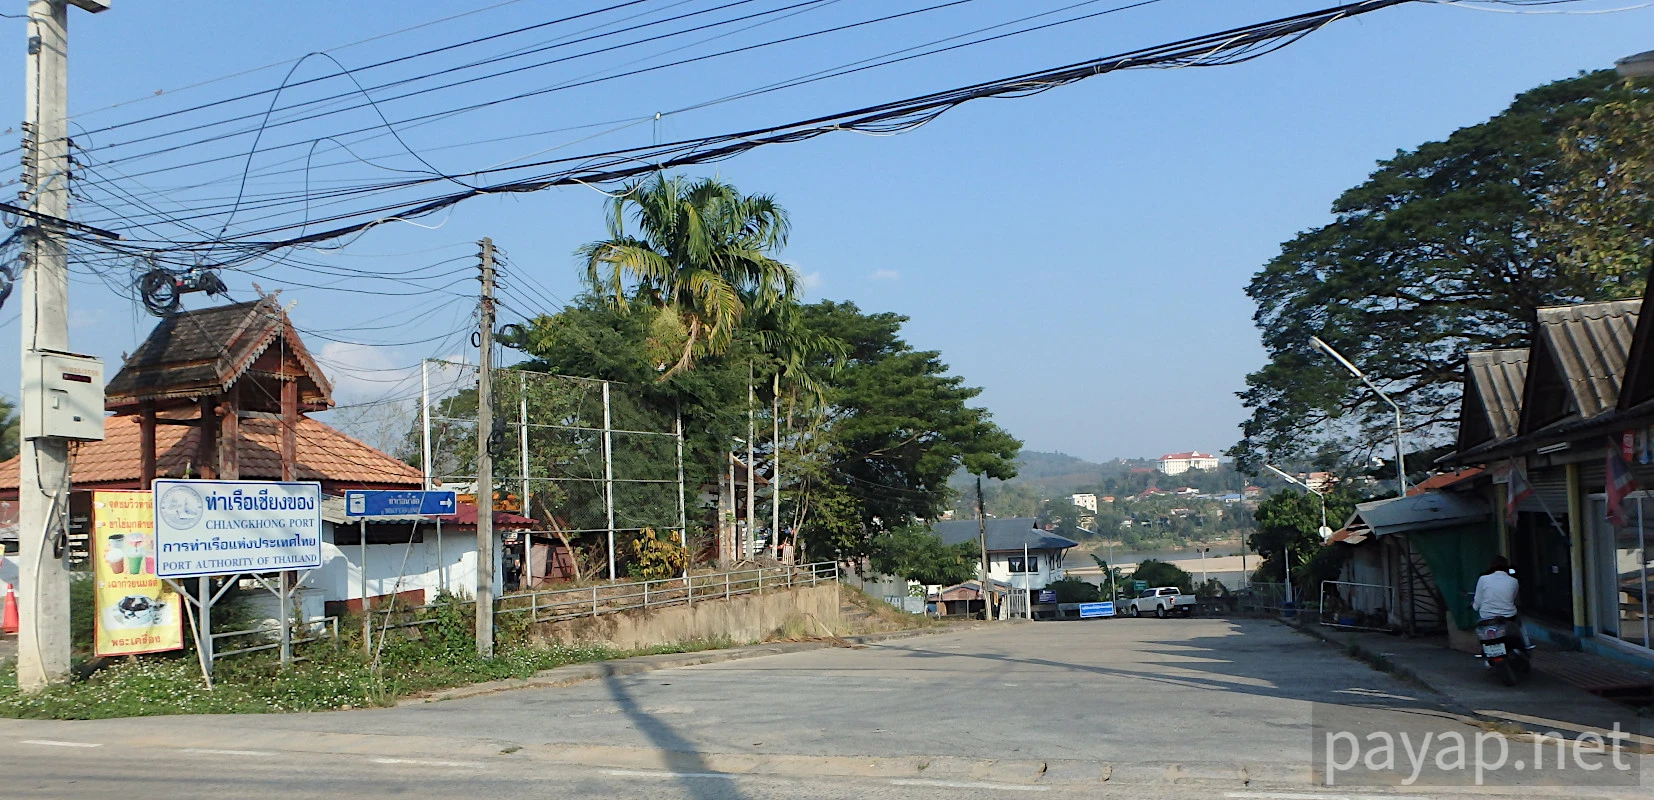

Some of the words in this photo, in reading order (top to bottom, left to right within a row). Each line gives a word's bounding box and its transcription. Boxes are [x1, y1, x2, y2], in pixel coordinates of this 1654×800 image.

[109, 498, 153, 513] จุดชมวิวท่าเ
[205, 488, 314, 511] ท่าเรือเชียงของ
[109, 517, 154, 533] ชาไข่มุกสาย
[205, 519, 286, 530] CHIANGKHONG
[289, 518, 315, 528] PORT
[163, 534, 316, 552] การท่าเรือแห่งประเทศไทย
[162, 560, 192, 571] PORT
[195, 557, 253, 569] AUTHORITY
[257, 556, 270, 565] OF
[273, 554, 317, 564] THAILAND
[111, 632, 161, 647] พระเครื่อง
